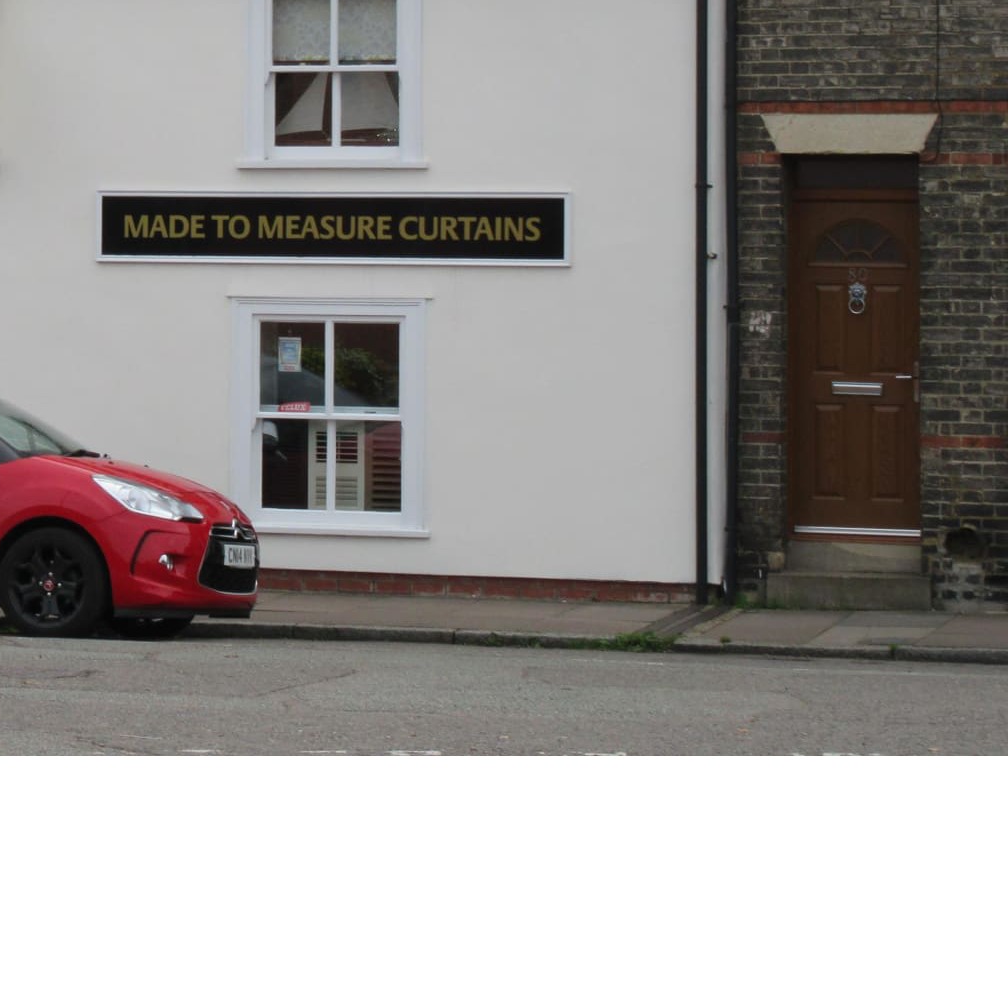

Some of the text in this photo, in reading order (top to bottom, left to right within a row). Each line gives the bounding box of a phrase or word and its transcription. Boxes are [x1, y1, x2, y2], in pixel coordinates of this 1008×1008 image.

[123, 214, 541, 242] MADE TO MEASURE CURTAINS
